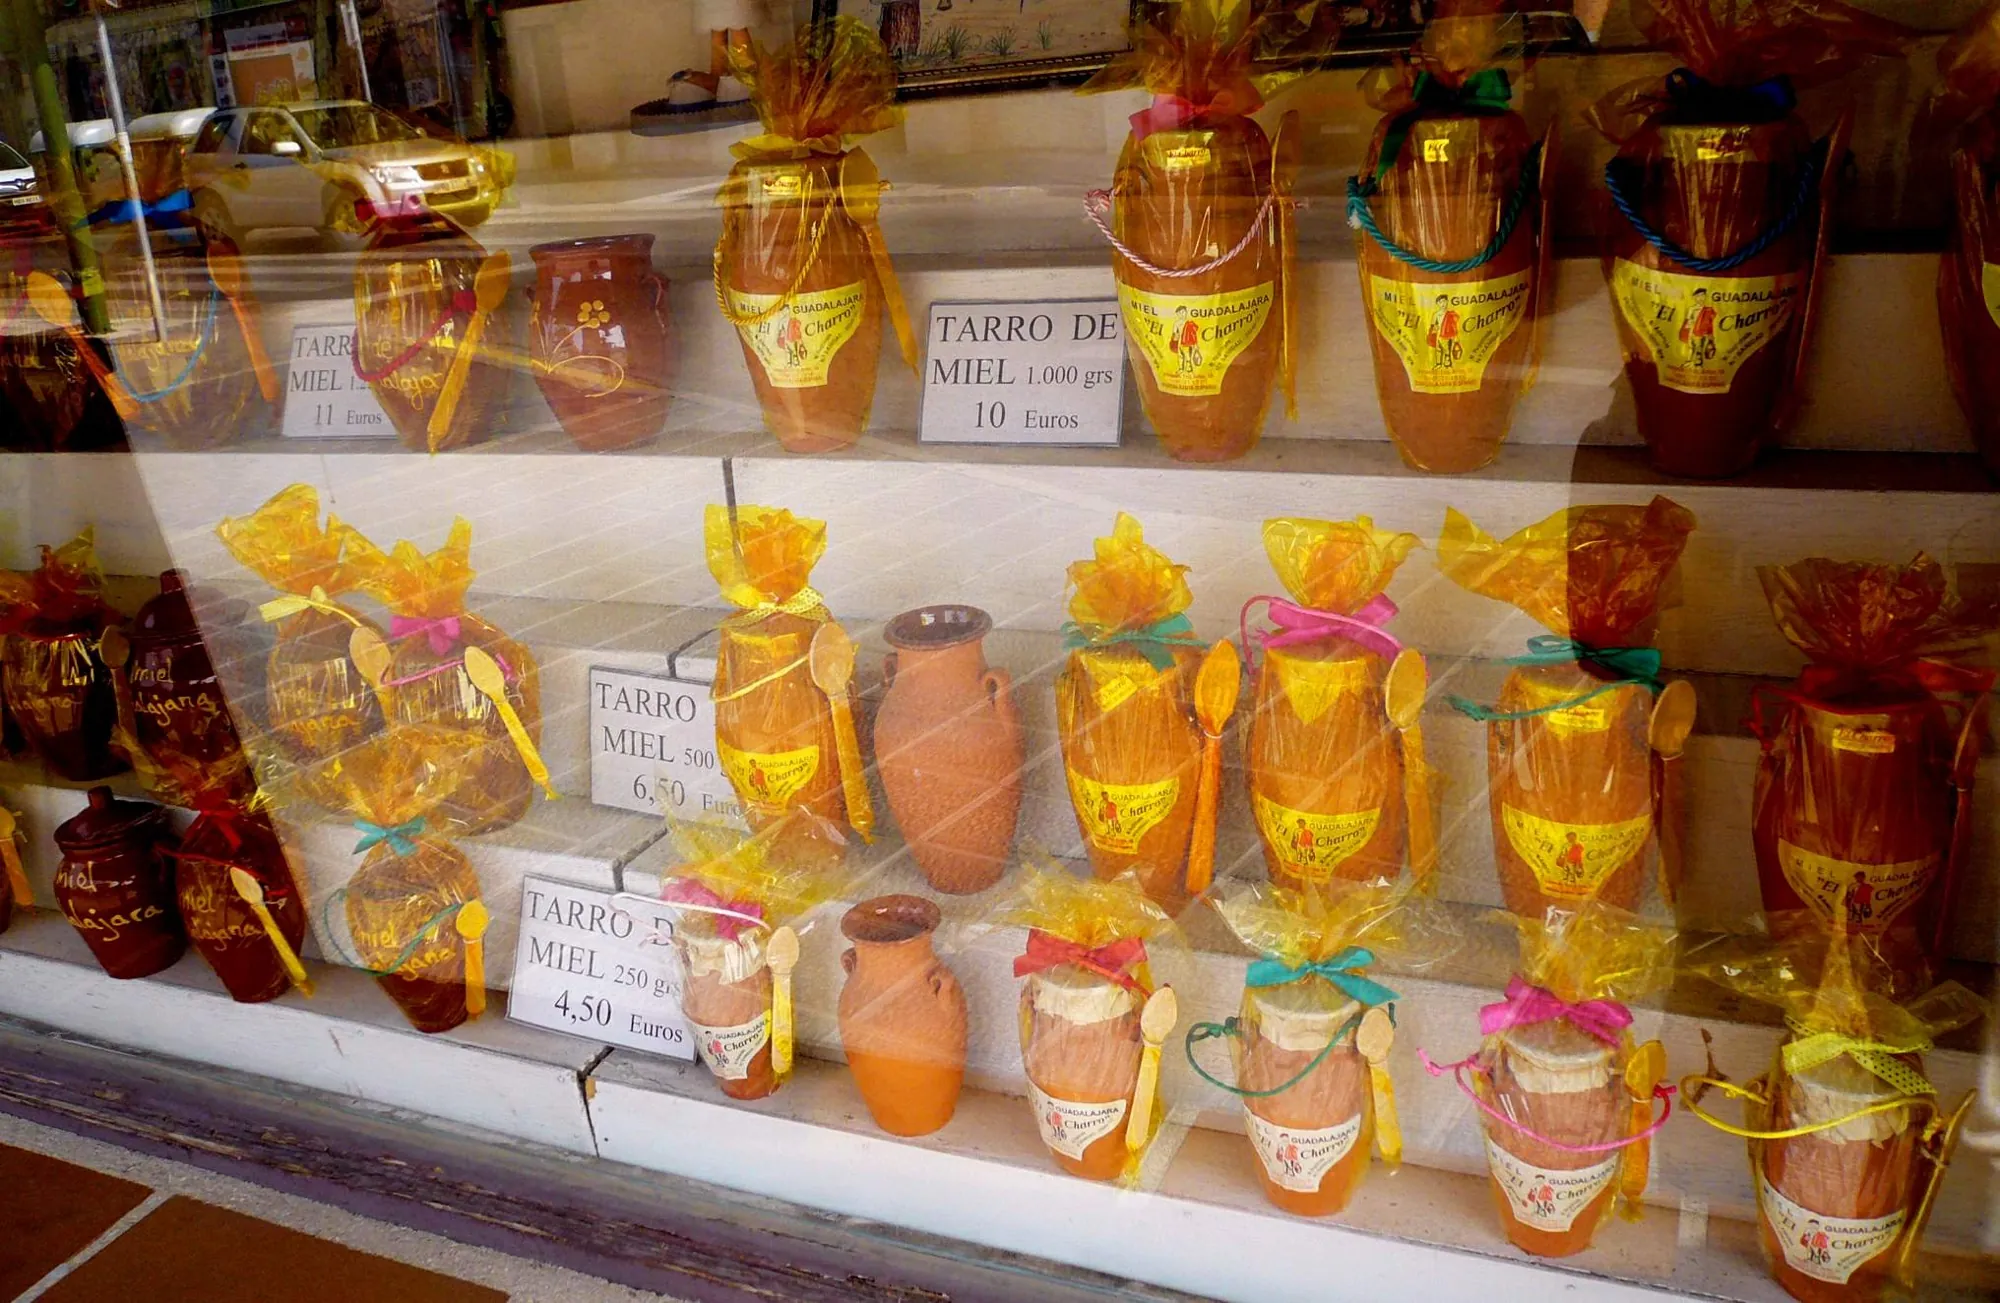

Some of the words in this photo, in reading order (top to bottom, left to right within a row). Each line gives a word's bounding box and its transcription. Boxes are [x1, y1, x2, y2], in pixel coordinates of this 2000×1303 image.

[1131, 300, 1159, 317] MIEL
[1190, 294, 1270, 318] GUADALAJARA
[936, 313, 1054, 343] TARRO
[1071, 312, 1119, 341] DE
[294, 334, 352, 358] TARR
[290, 369, 343, 393] MIEL
[930, 357, 1016, 386] MIEL
[1027, 364, 1079, 386] 1.000
[1083, 368, 1114, 390] grs
[314, 403, 333, 426] 11
[346, 409, 383, 426] Euros
[975, 400, 1007, 429] 10
[1024, 409, 1080, 430] Euros
[595, 682, 697, 723] TARRO
[602, 725, 675, 763] MIEL
[684, 747, 714, 770] 500
[633, 773, 686, 807] 6,50
[701, 793, 742, 816] Euro
[527, 889, 634, 939] TARRO
[528, 935, 605, 980] MIEL
[613, 964, 649, 990] 250
[653, 978, 681, 998] grs
[554, 989, 613, 1027] 4,50
[629, 1013, 683, 1043] Euros
